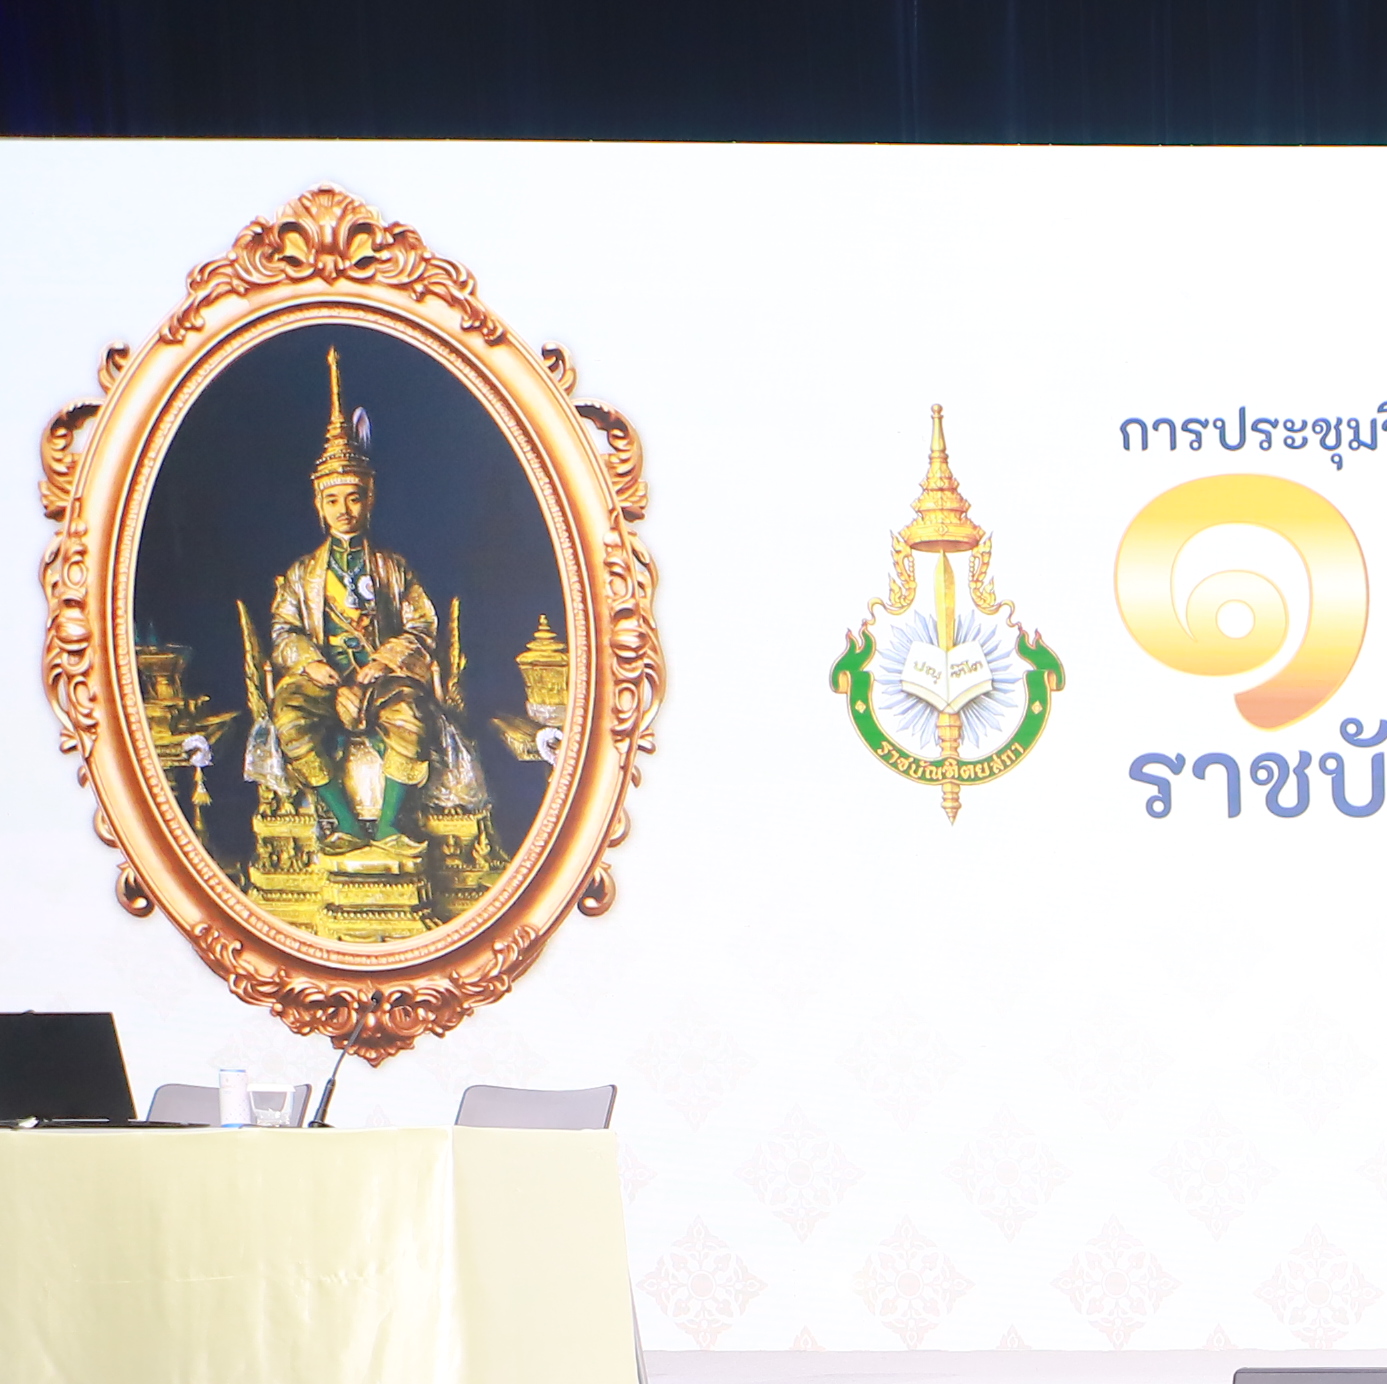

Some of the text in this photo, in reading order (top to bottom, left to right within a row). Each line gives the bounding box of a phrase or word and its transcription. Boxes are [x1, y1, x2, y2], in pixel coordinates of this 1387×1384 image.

[876, 741, 1025, 780] ราชบัณฑิตยสภา
